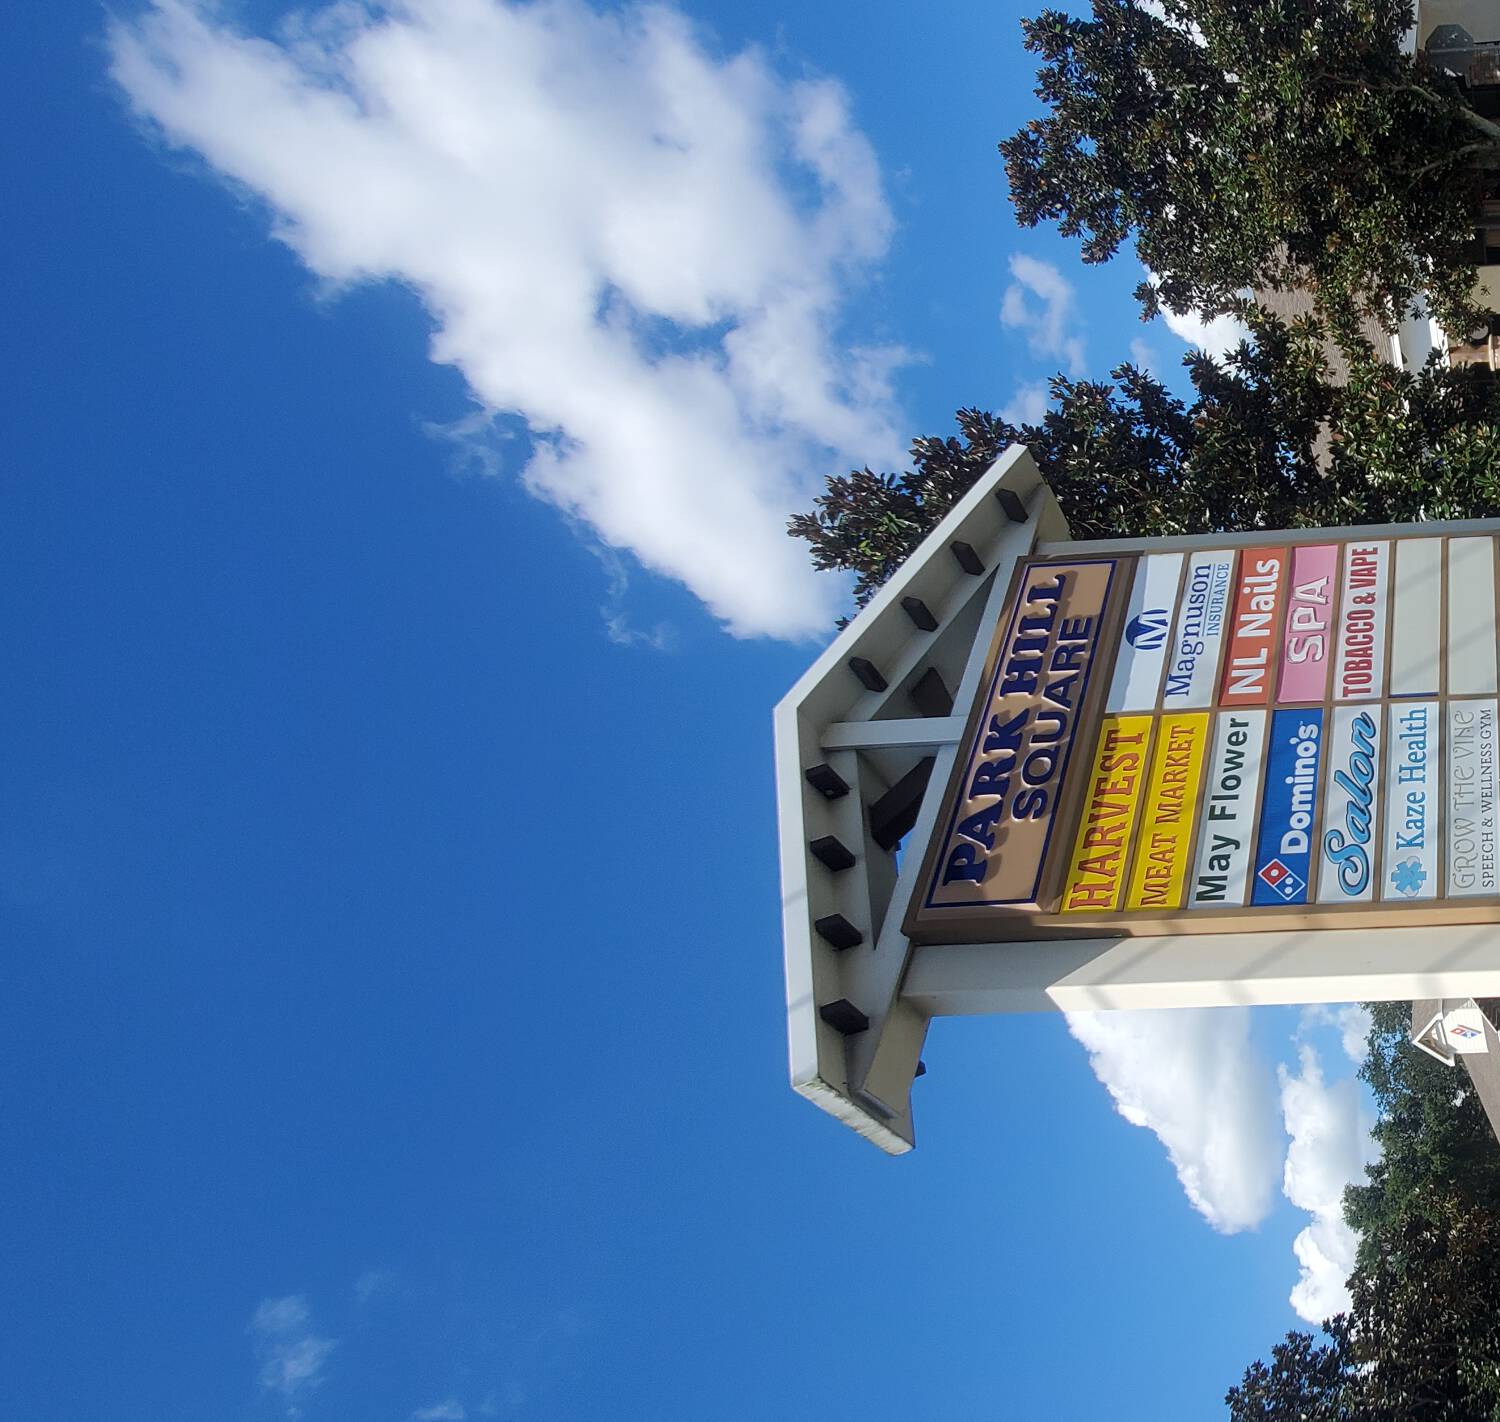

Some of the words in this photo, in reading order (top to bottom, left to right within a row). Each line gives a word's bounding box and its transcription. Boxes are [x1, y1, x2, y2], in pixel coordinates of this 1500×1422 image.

[1206, 563, 1229, 636] INSURANCE
[1237, 559, 1280, 637] Nails
[1350, 547, 1378, 589] VAPE
[1353, 591, 1376, 605] &
[1165, 563, 1211, 698] Magnuson
[1287, 576, 1330, 663] SPA
[1343, 609, 1376, 698] TOBACCO
[1229, 647, 1268, 694] NL
[943, 708, 1031, 886] PARK
[1000, 574, 1066, 699] HILL
[1011, 615, 1093, 822] SQUARE
[1398, 707, 1428, 784] Health
[1454, 710, 1475, 760] VINE
[1480, 708, 1492, 740] GYM
[1155, 725, 1196, 824] MARKET
[1208, 718, 1249, 820] Flower
[1280, 723, 1319, 854] Domino's
[1324, 711, 1376, 896] Salon
[1454, 766, 1476, 811] THE
[1480, 744, 1493, 814] WELLNESS
[1069, 728, 1145, 909] HARVEST
[1396, 791, 1426, 850] Kaze
[1453, 817, 1478, 888] GROW
[1482, 817, 1493, 827] &
[1141, 833, 1178, 906] MEAT
[1196, 834, 1240, 901] May
[1482, 832, 1494, 888] SPEECH
